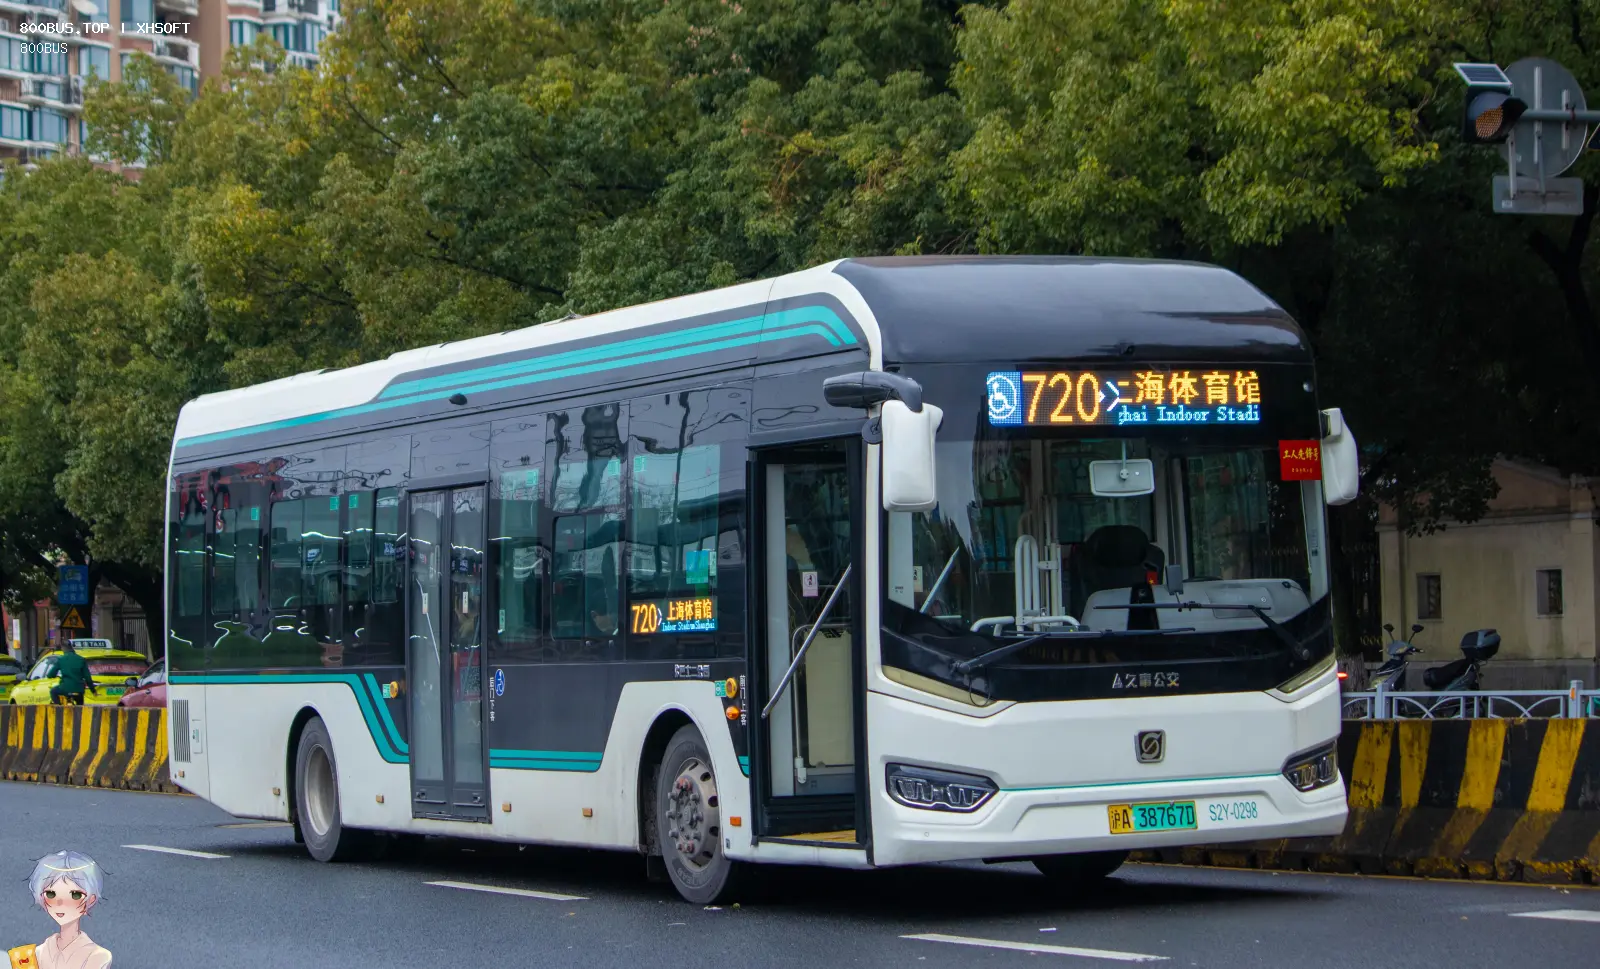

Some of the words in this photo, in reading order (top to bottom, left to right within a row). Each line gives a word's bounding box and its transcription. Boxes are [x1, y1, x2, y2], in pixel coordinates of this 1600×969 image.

[1022, 373, 1101, 423] 720
[1157, 406, 1208, 422] Indoor
[1216, 405, 1260, 422] Stadi
[631, 603, 658, 633] 720
[666, 599, 713, 621] 上海体育馆
[1137, 805, 1195, 828] 38767D
[1208, 801, 1259, 822] S2Y-0298
